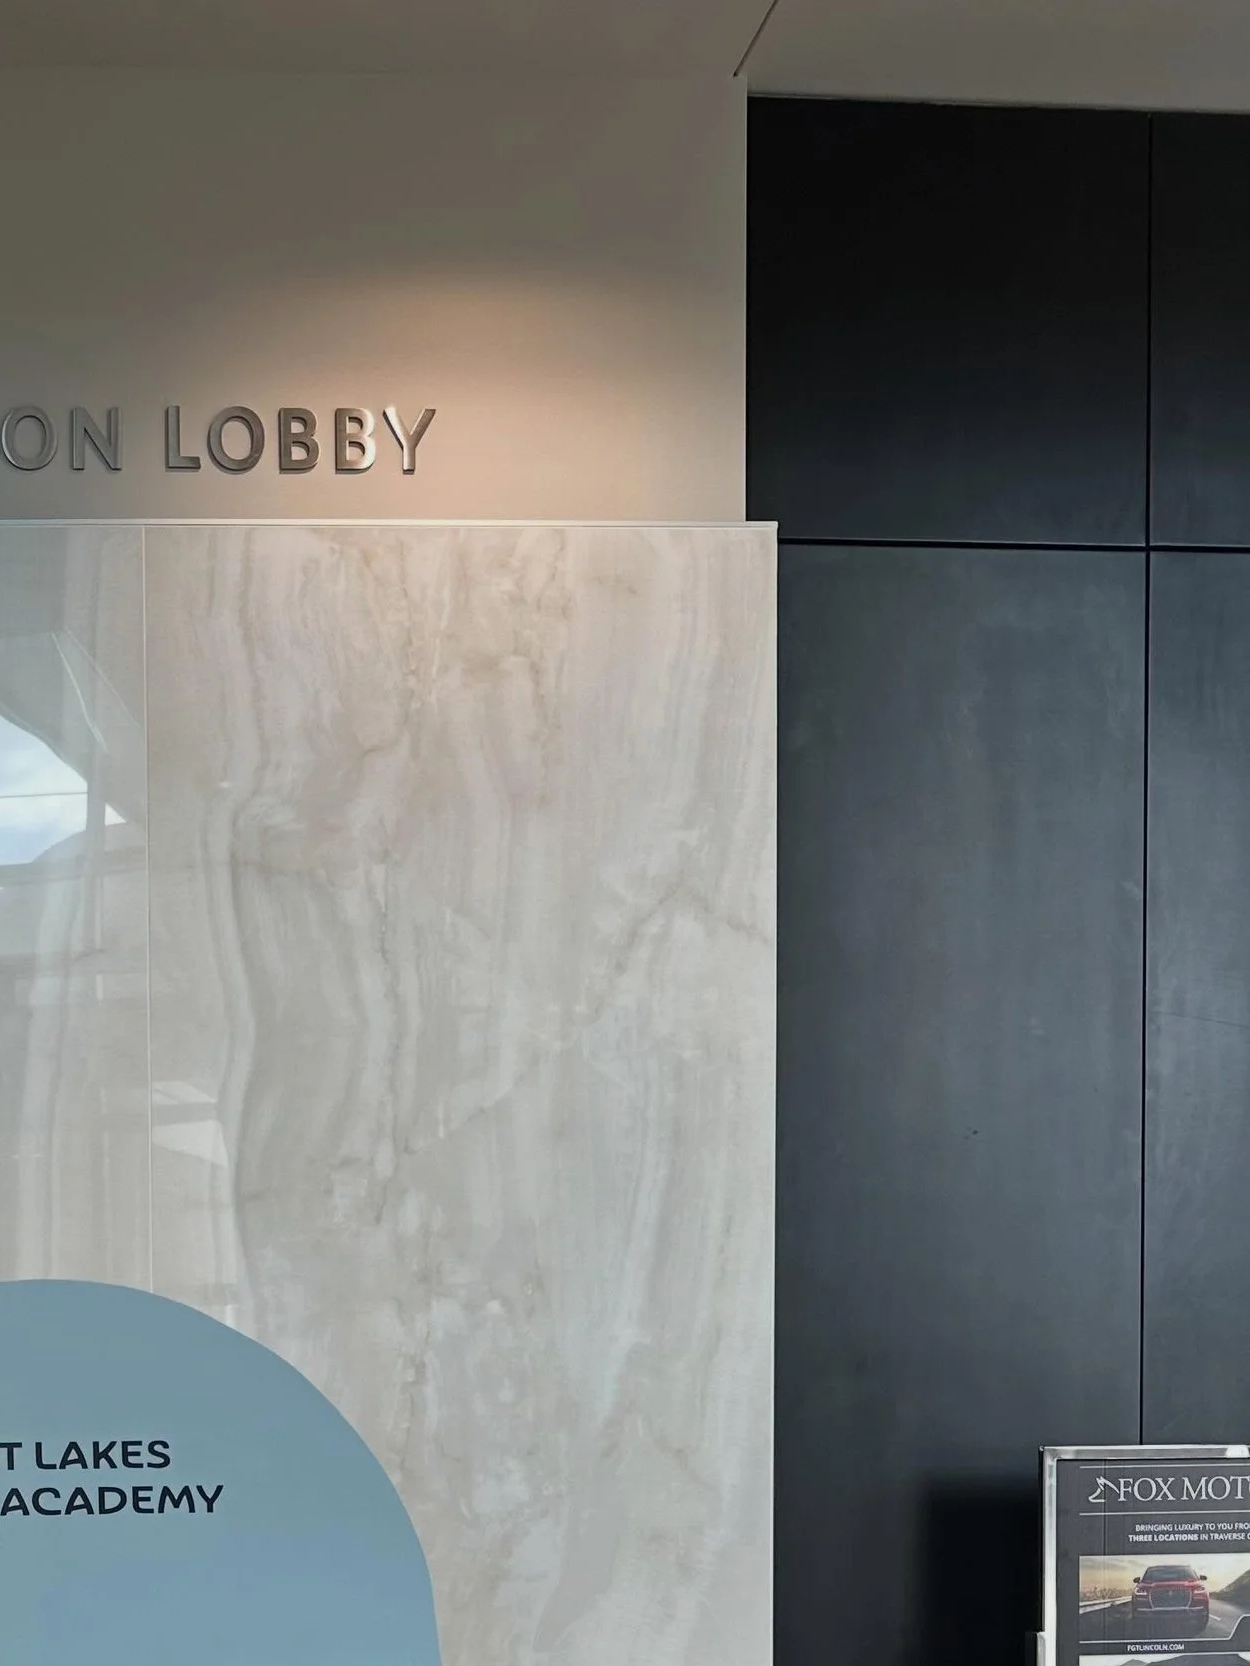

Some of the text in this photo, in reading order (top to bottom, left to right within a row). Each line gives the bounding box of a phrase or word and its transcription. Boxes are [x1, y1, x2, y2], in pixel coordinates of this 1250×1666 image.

[165, 404, 437, 475] LOBBY
[34, 1440, 171, 1470] LAKES
[0, 1484, 225, 1516] ACADEMY
[1117, 1476, 1250, 1502] FOX MOT
[1128, 1534, 1153, 1542] THREE
[1153, 1533, 1199, 1542] LOCATIONS
[1199, 1533, 1209, 1541] IN
[1210, 1532, 1246, 1541] TRAVERSE
[1135, 1522, 1250, 1532] BRINGING LUXURY TO YOU FRO
